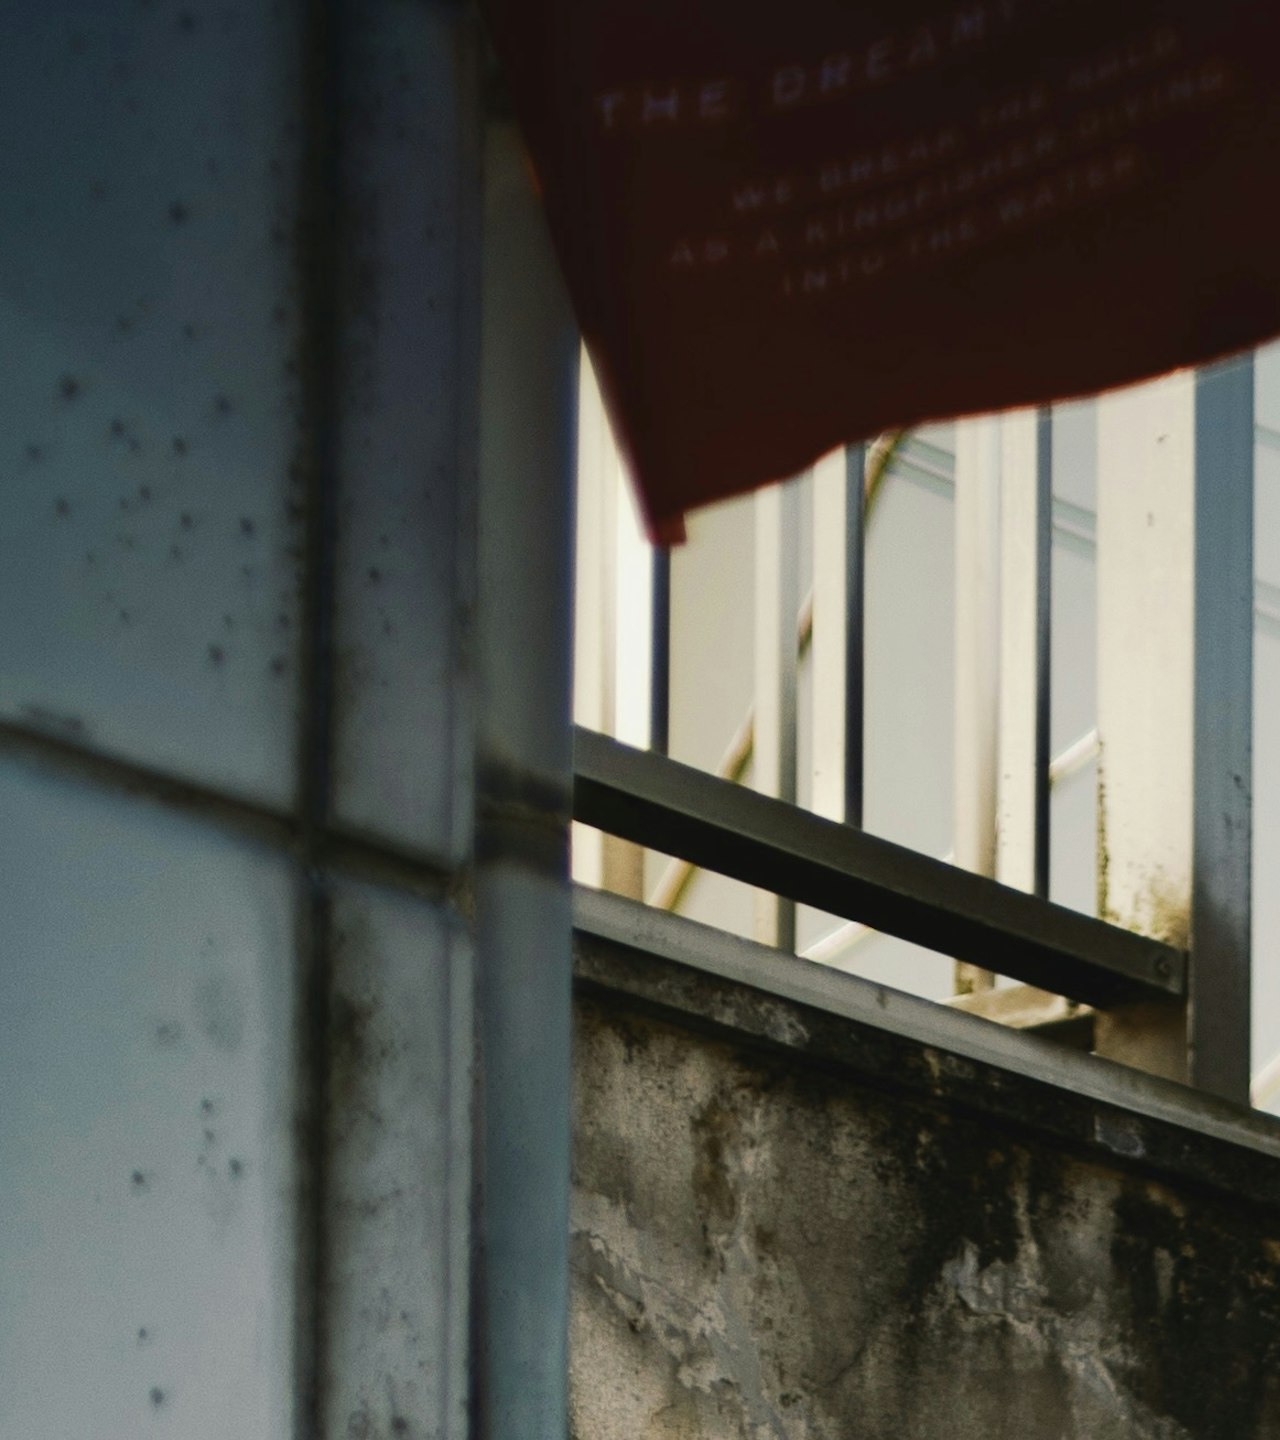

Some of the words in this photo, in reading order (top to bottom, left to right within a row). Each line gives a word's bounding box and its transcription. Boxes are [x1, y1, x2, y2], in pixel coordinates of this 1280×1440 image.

[594, 80, 730, 130] THE
[733, 178, 793, 211] WE
[819, 128, 962, 193] BREAK
[998, 150, 1137, 226] WATER
